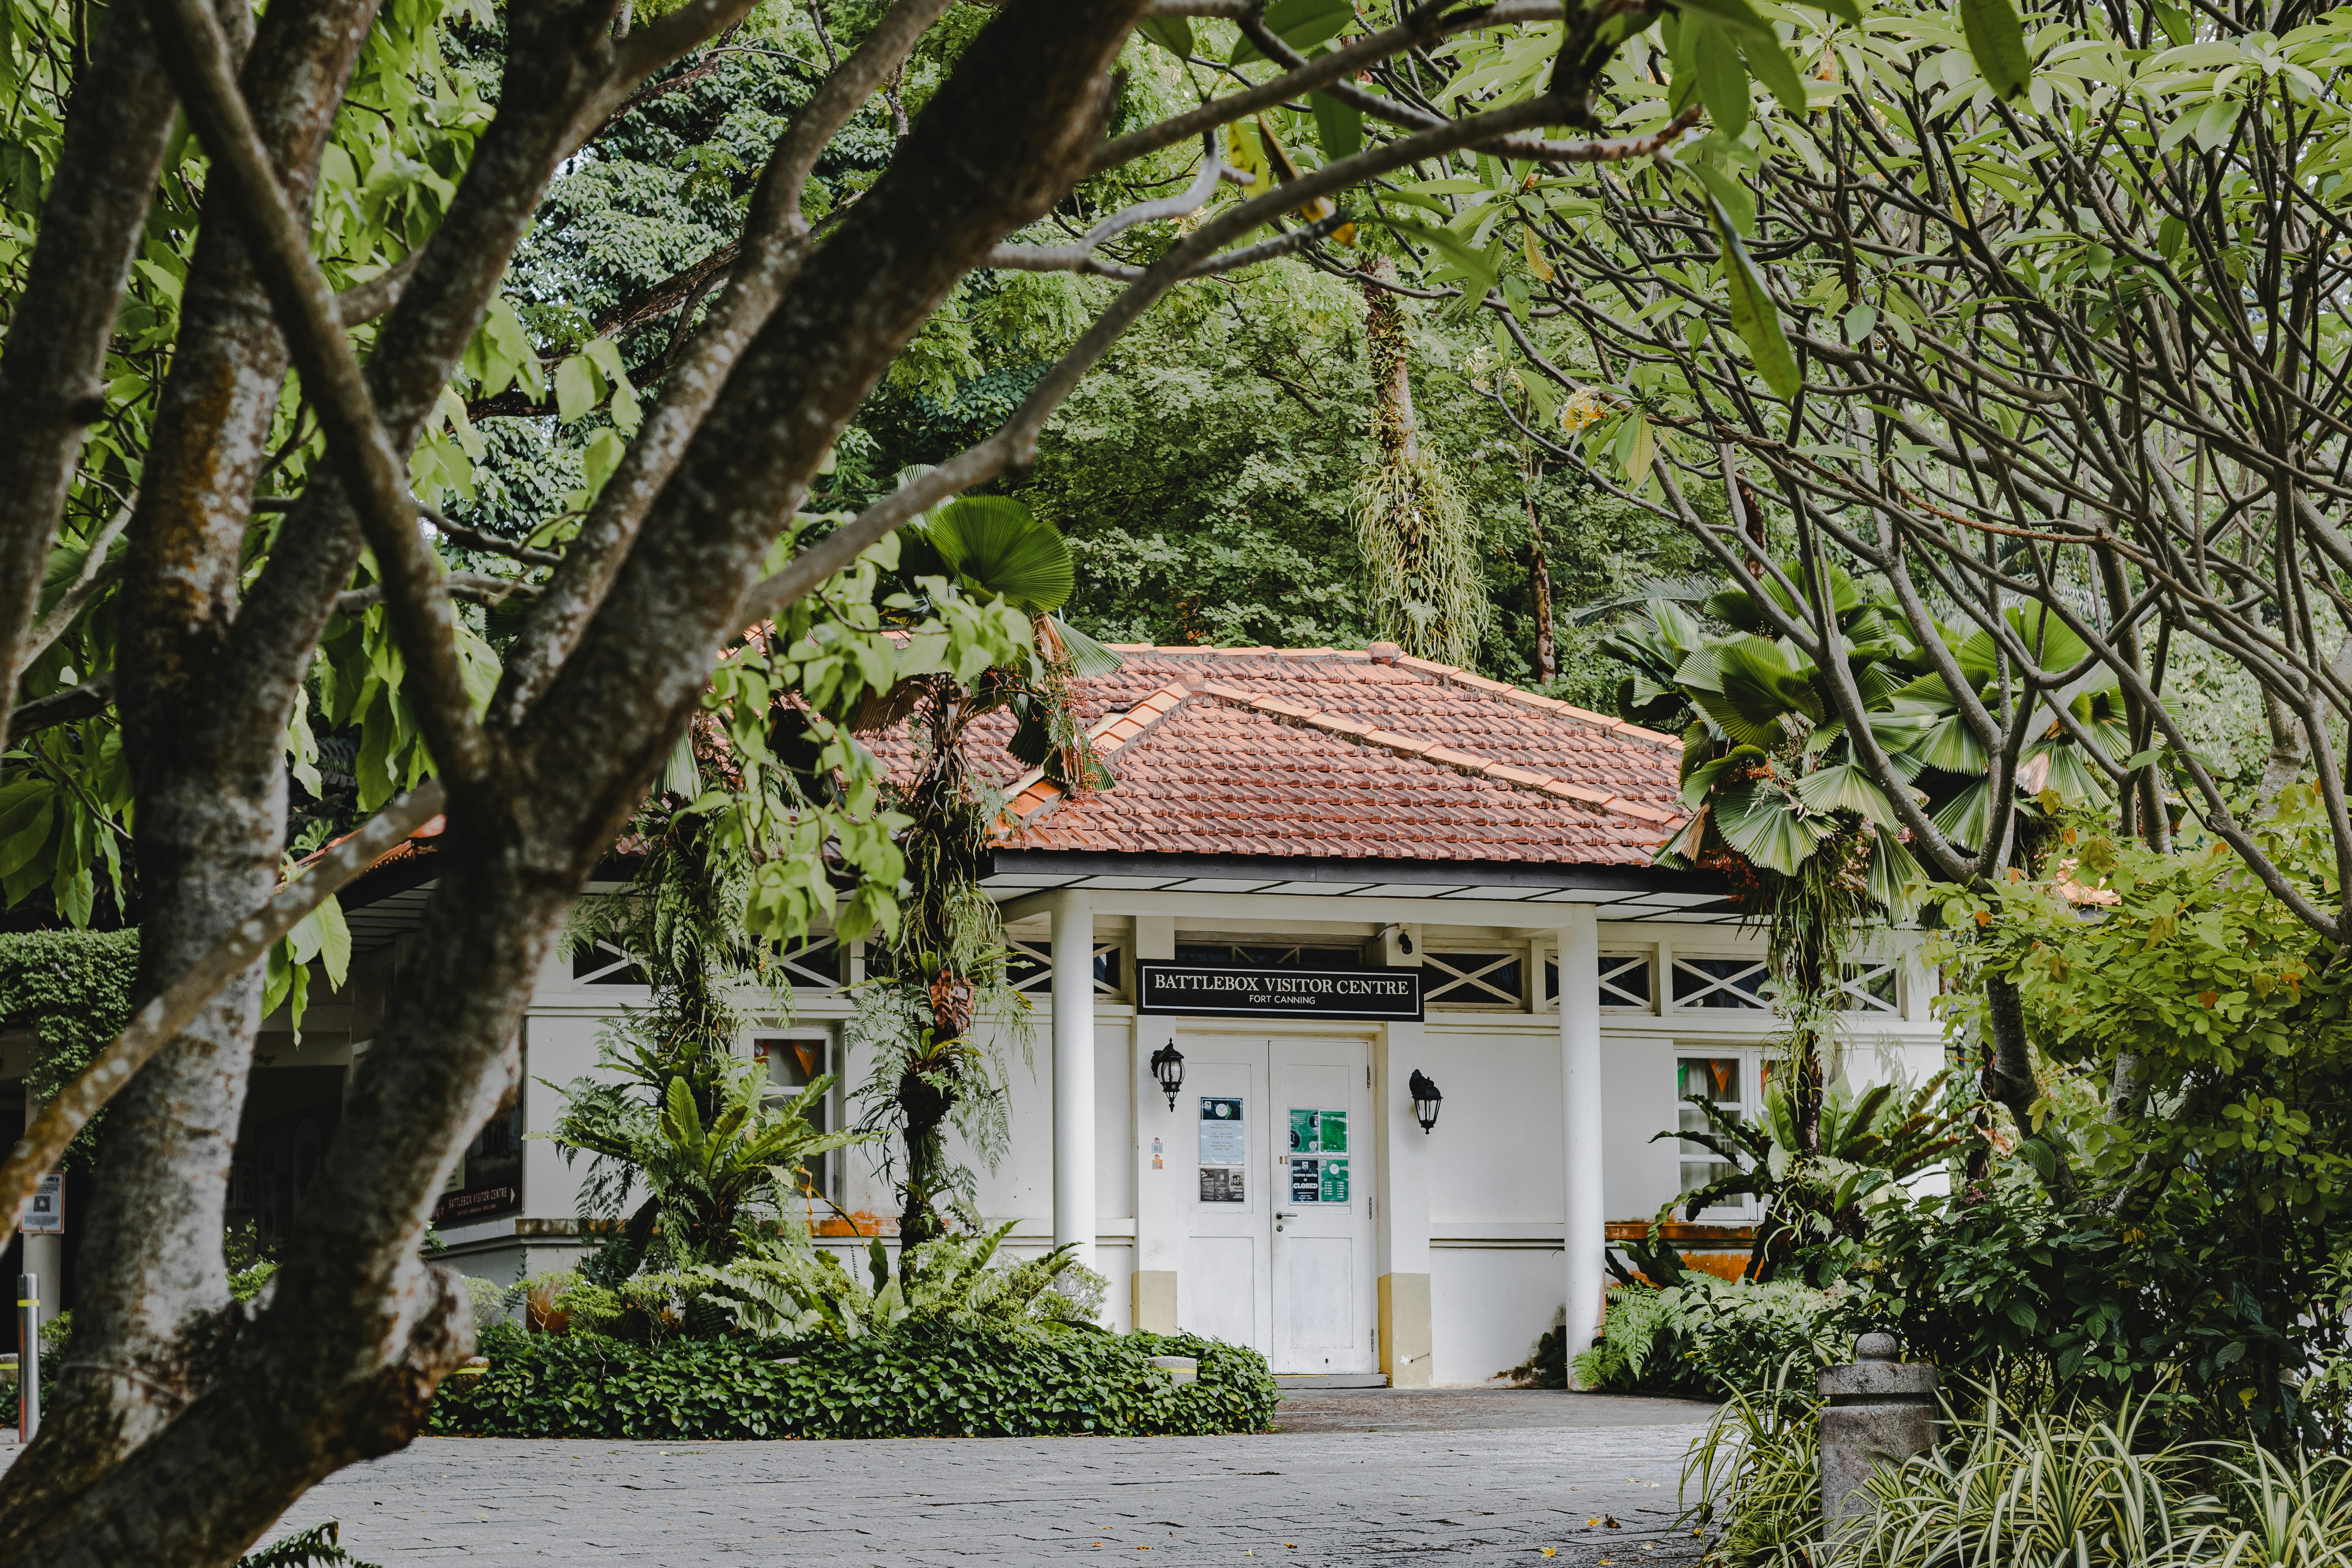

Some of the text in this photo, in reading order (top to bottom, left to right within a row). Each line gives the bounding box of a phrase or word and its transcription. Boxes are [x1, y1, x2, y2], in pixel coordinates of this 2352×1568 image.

[1155, 974, 1409, 995] BATTLEBOX VISITOR CENTRE
[1249, 995, 1316, 1004] FORT CANNING
[448, 1187, 507, 1209] BATTLEBOX VISITOR CENTRE
